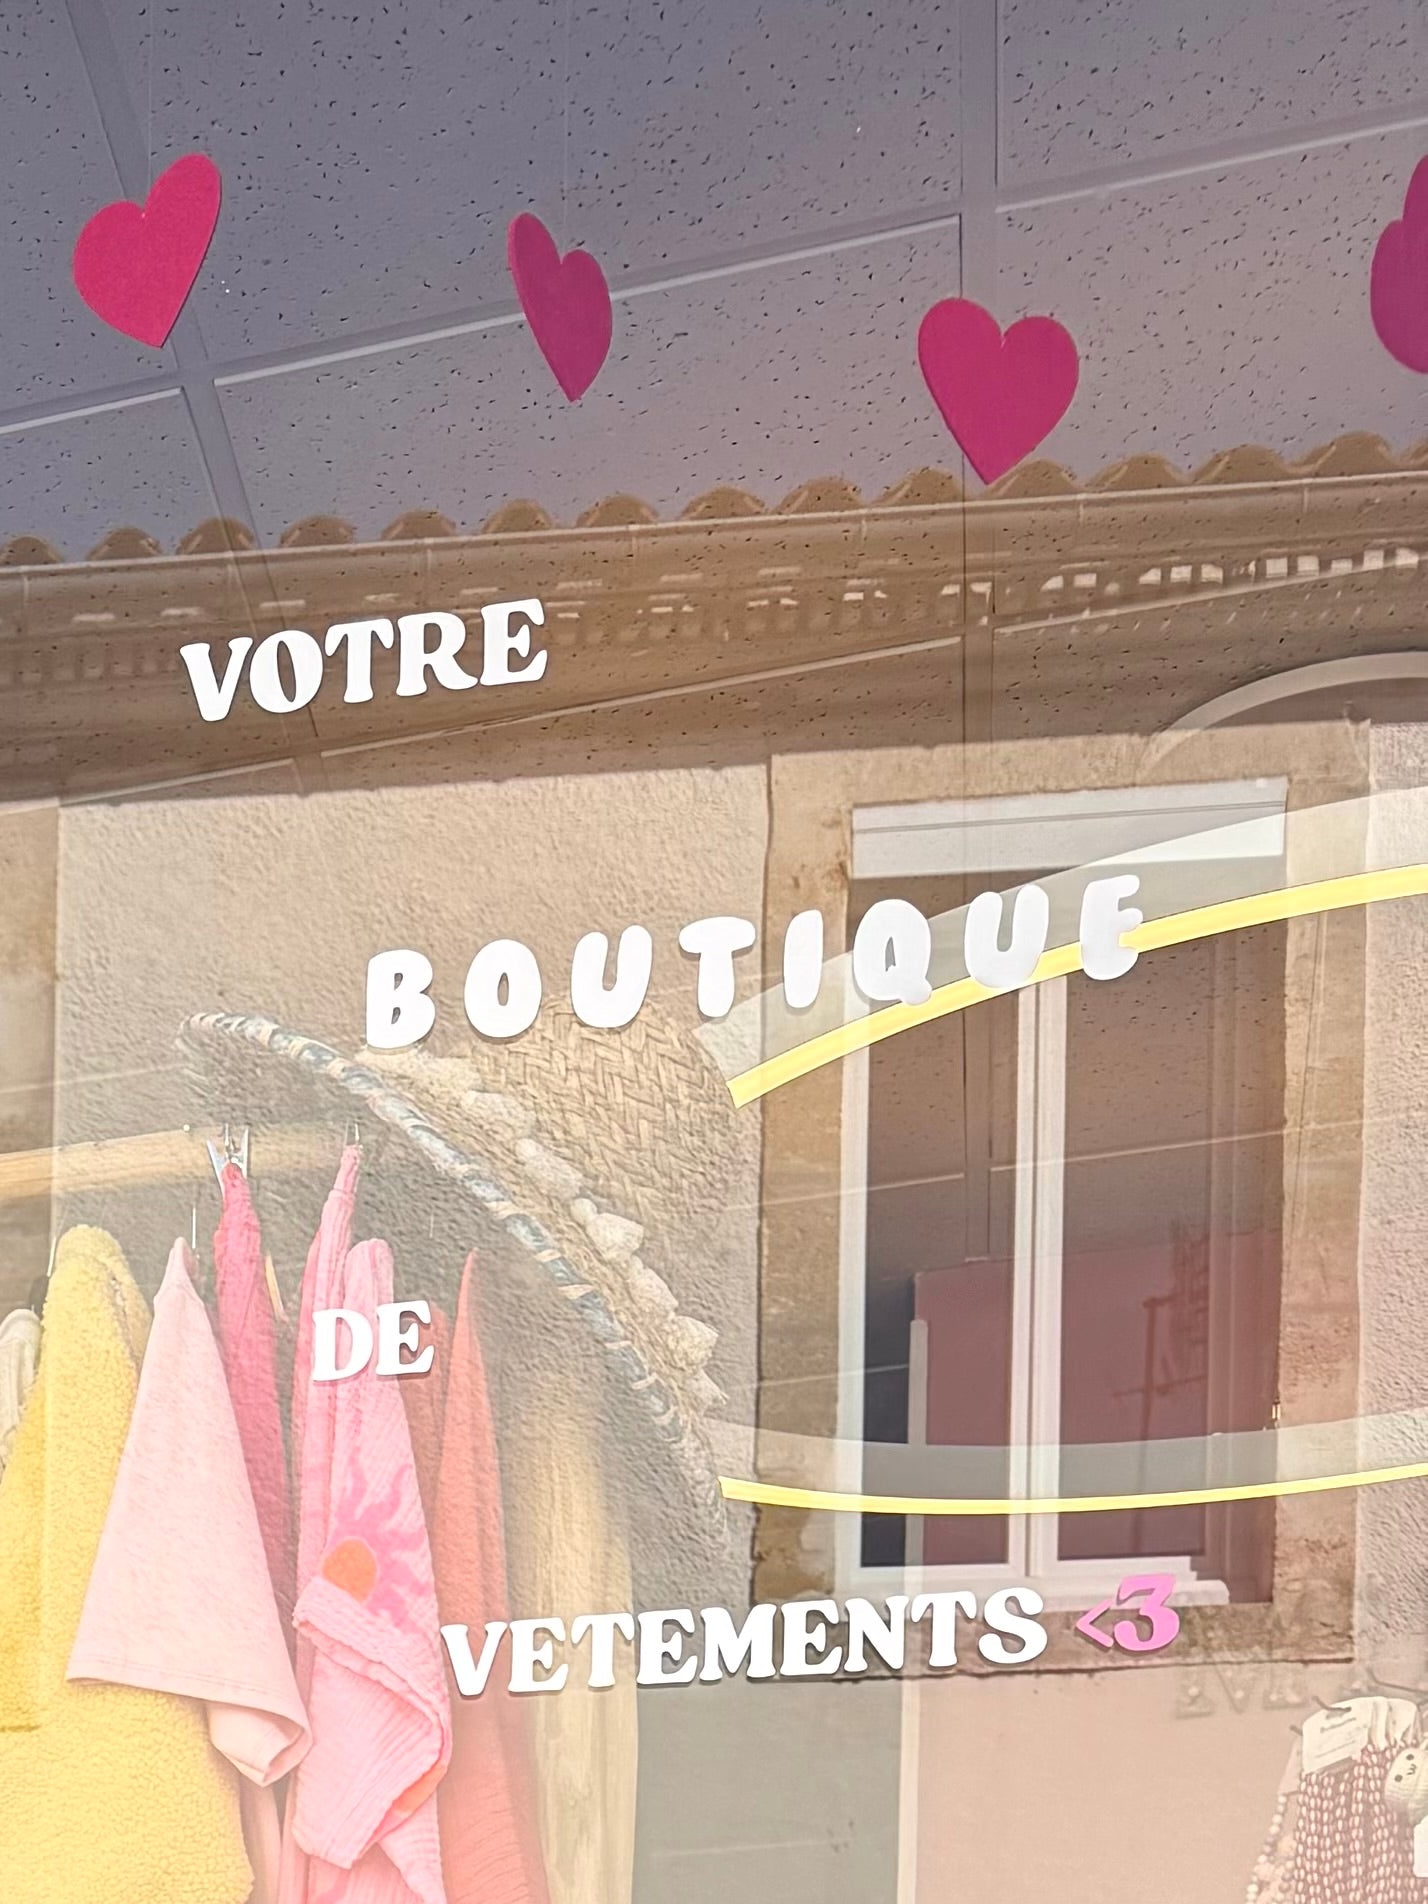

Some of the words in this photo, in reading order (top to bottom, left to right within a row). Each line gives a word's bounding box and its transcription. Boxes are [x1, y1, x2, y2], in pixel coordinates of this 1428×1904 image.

[180, 598, 549, 722] VOTRE
[364, 874, 1143, 1050] BOUTIQUE
[310, 1298, 436, 1384] DE
[440, 1586, 1049, 1698] VETEMENTS
